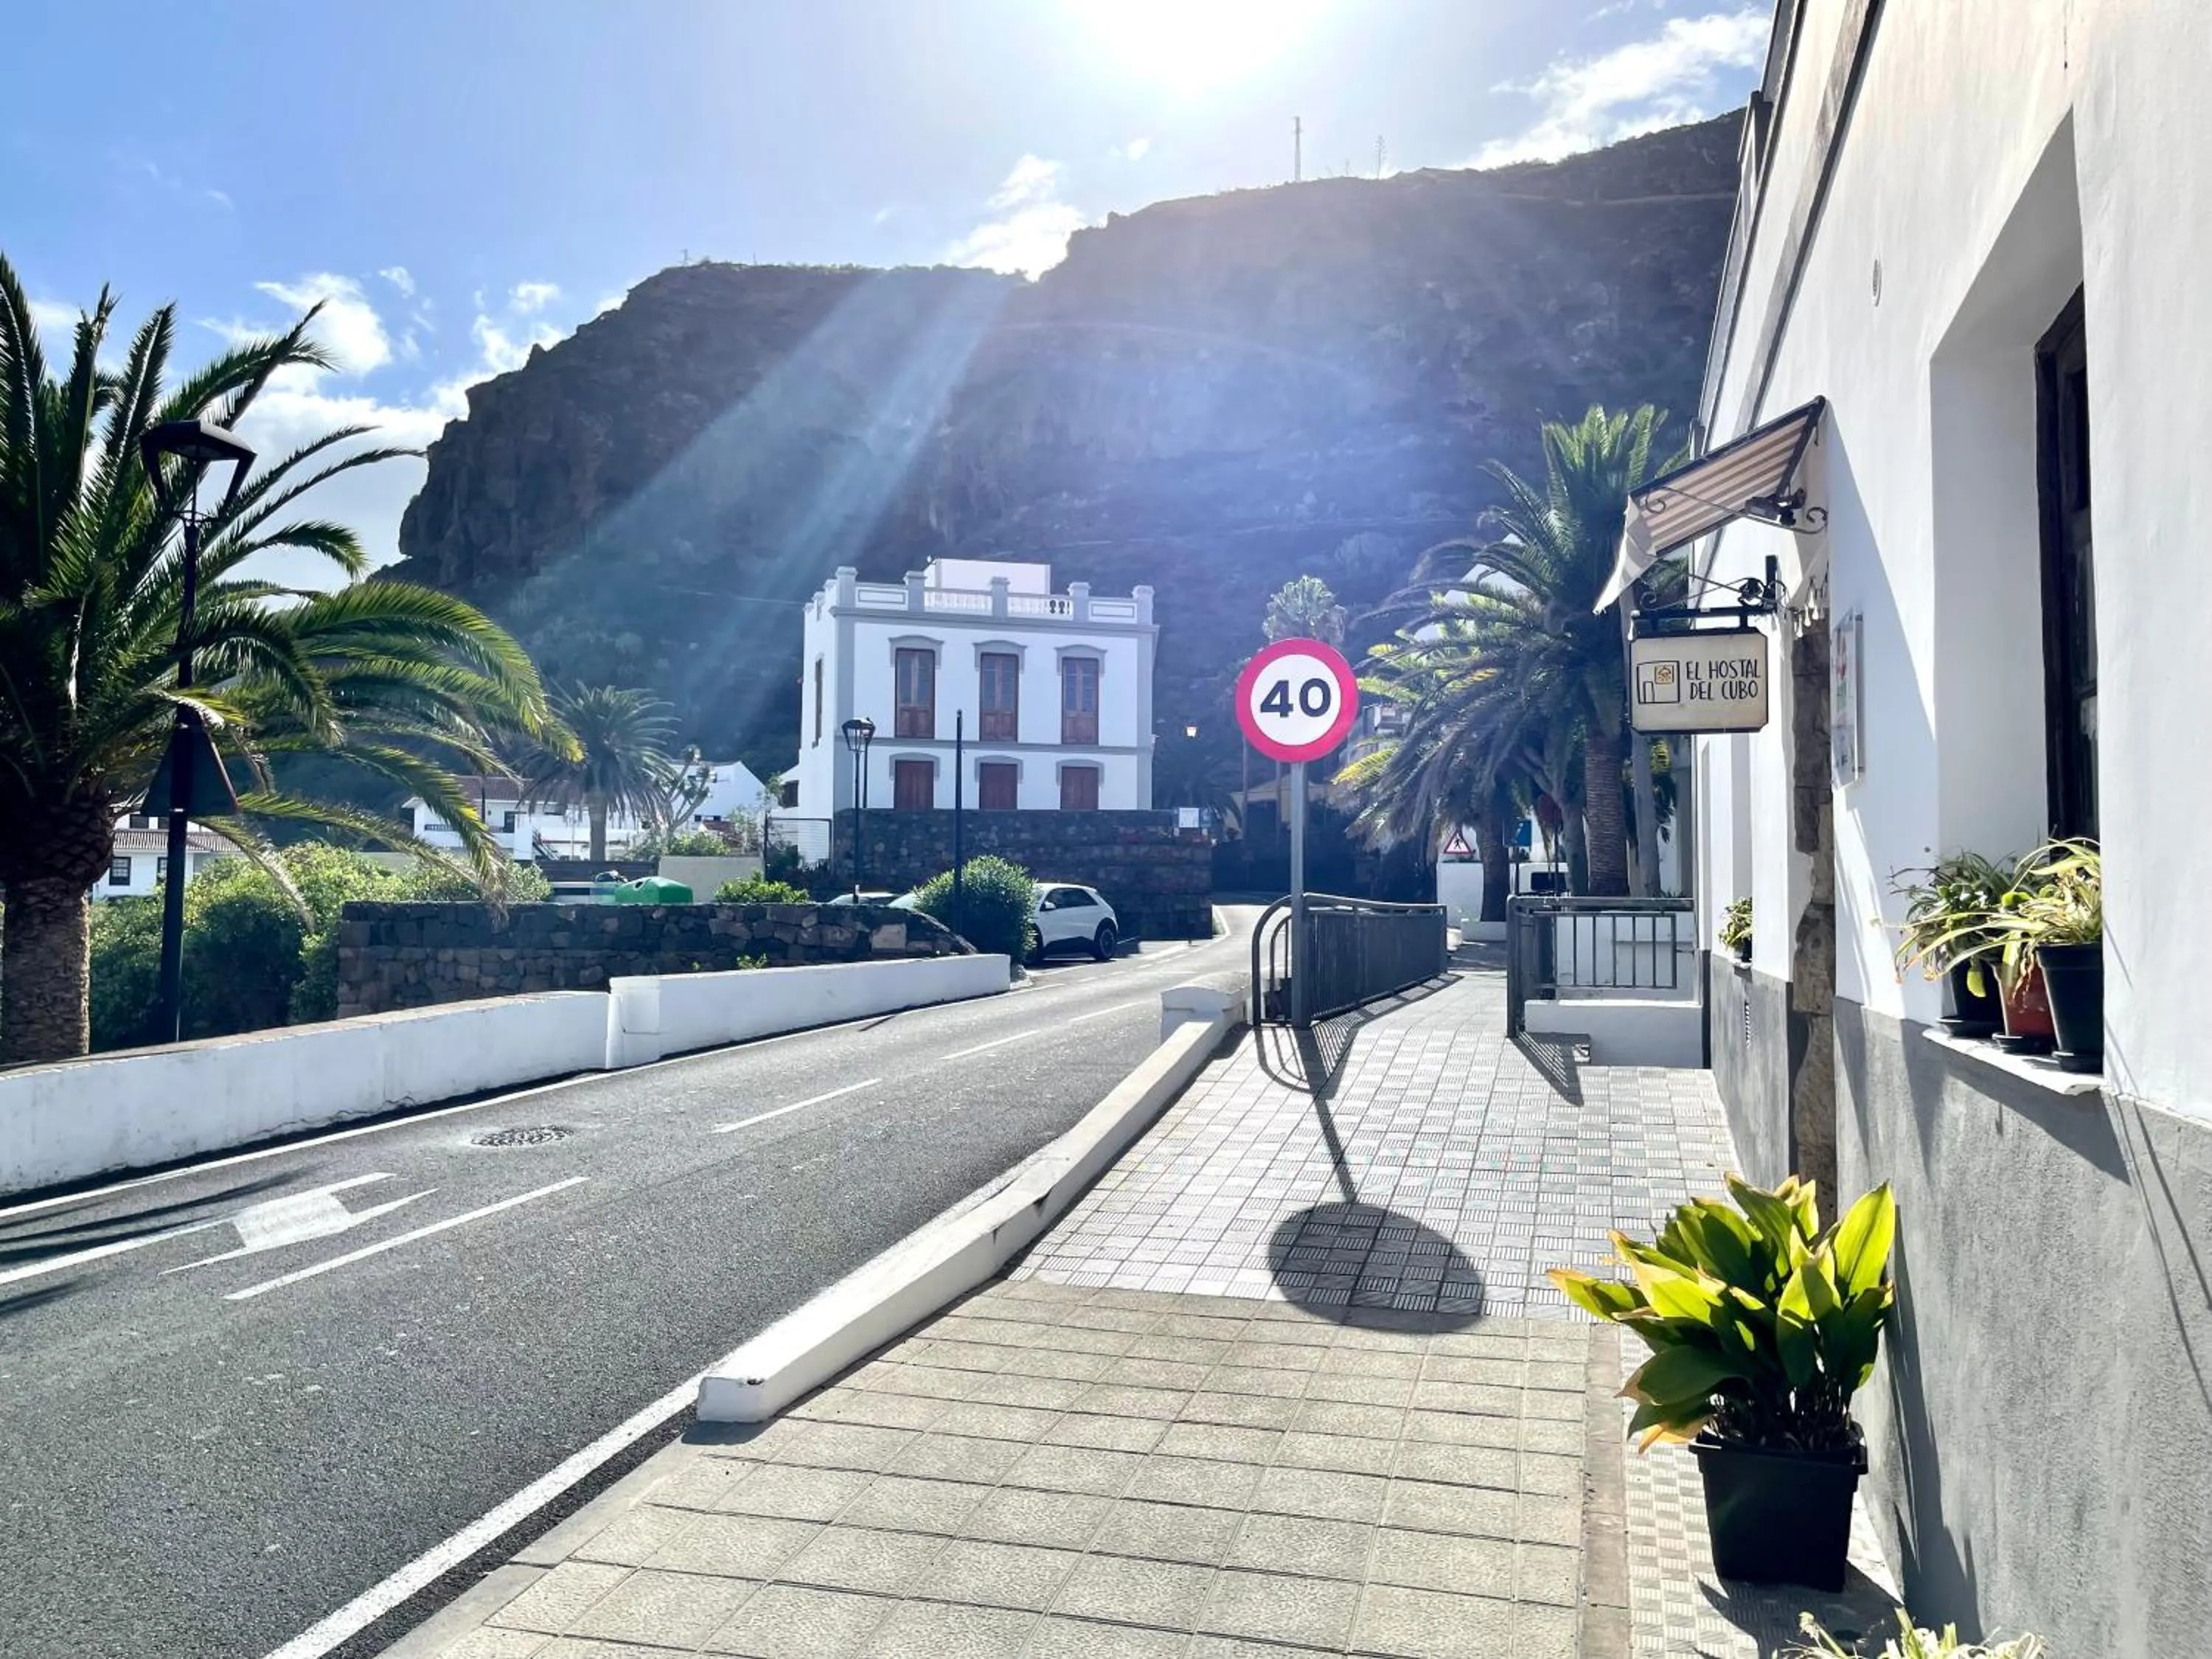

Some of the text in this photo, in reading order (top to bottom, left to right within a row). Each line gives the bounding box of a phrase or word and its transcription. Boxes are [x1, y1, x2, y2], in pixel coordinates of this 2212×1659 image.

[1686, 658, 1761, 681] EL HOSTAL
[1260, 678, 1332, 718] 40
[1689, 680, 1759, 700] DEL CUBO
